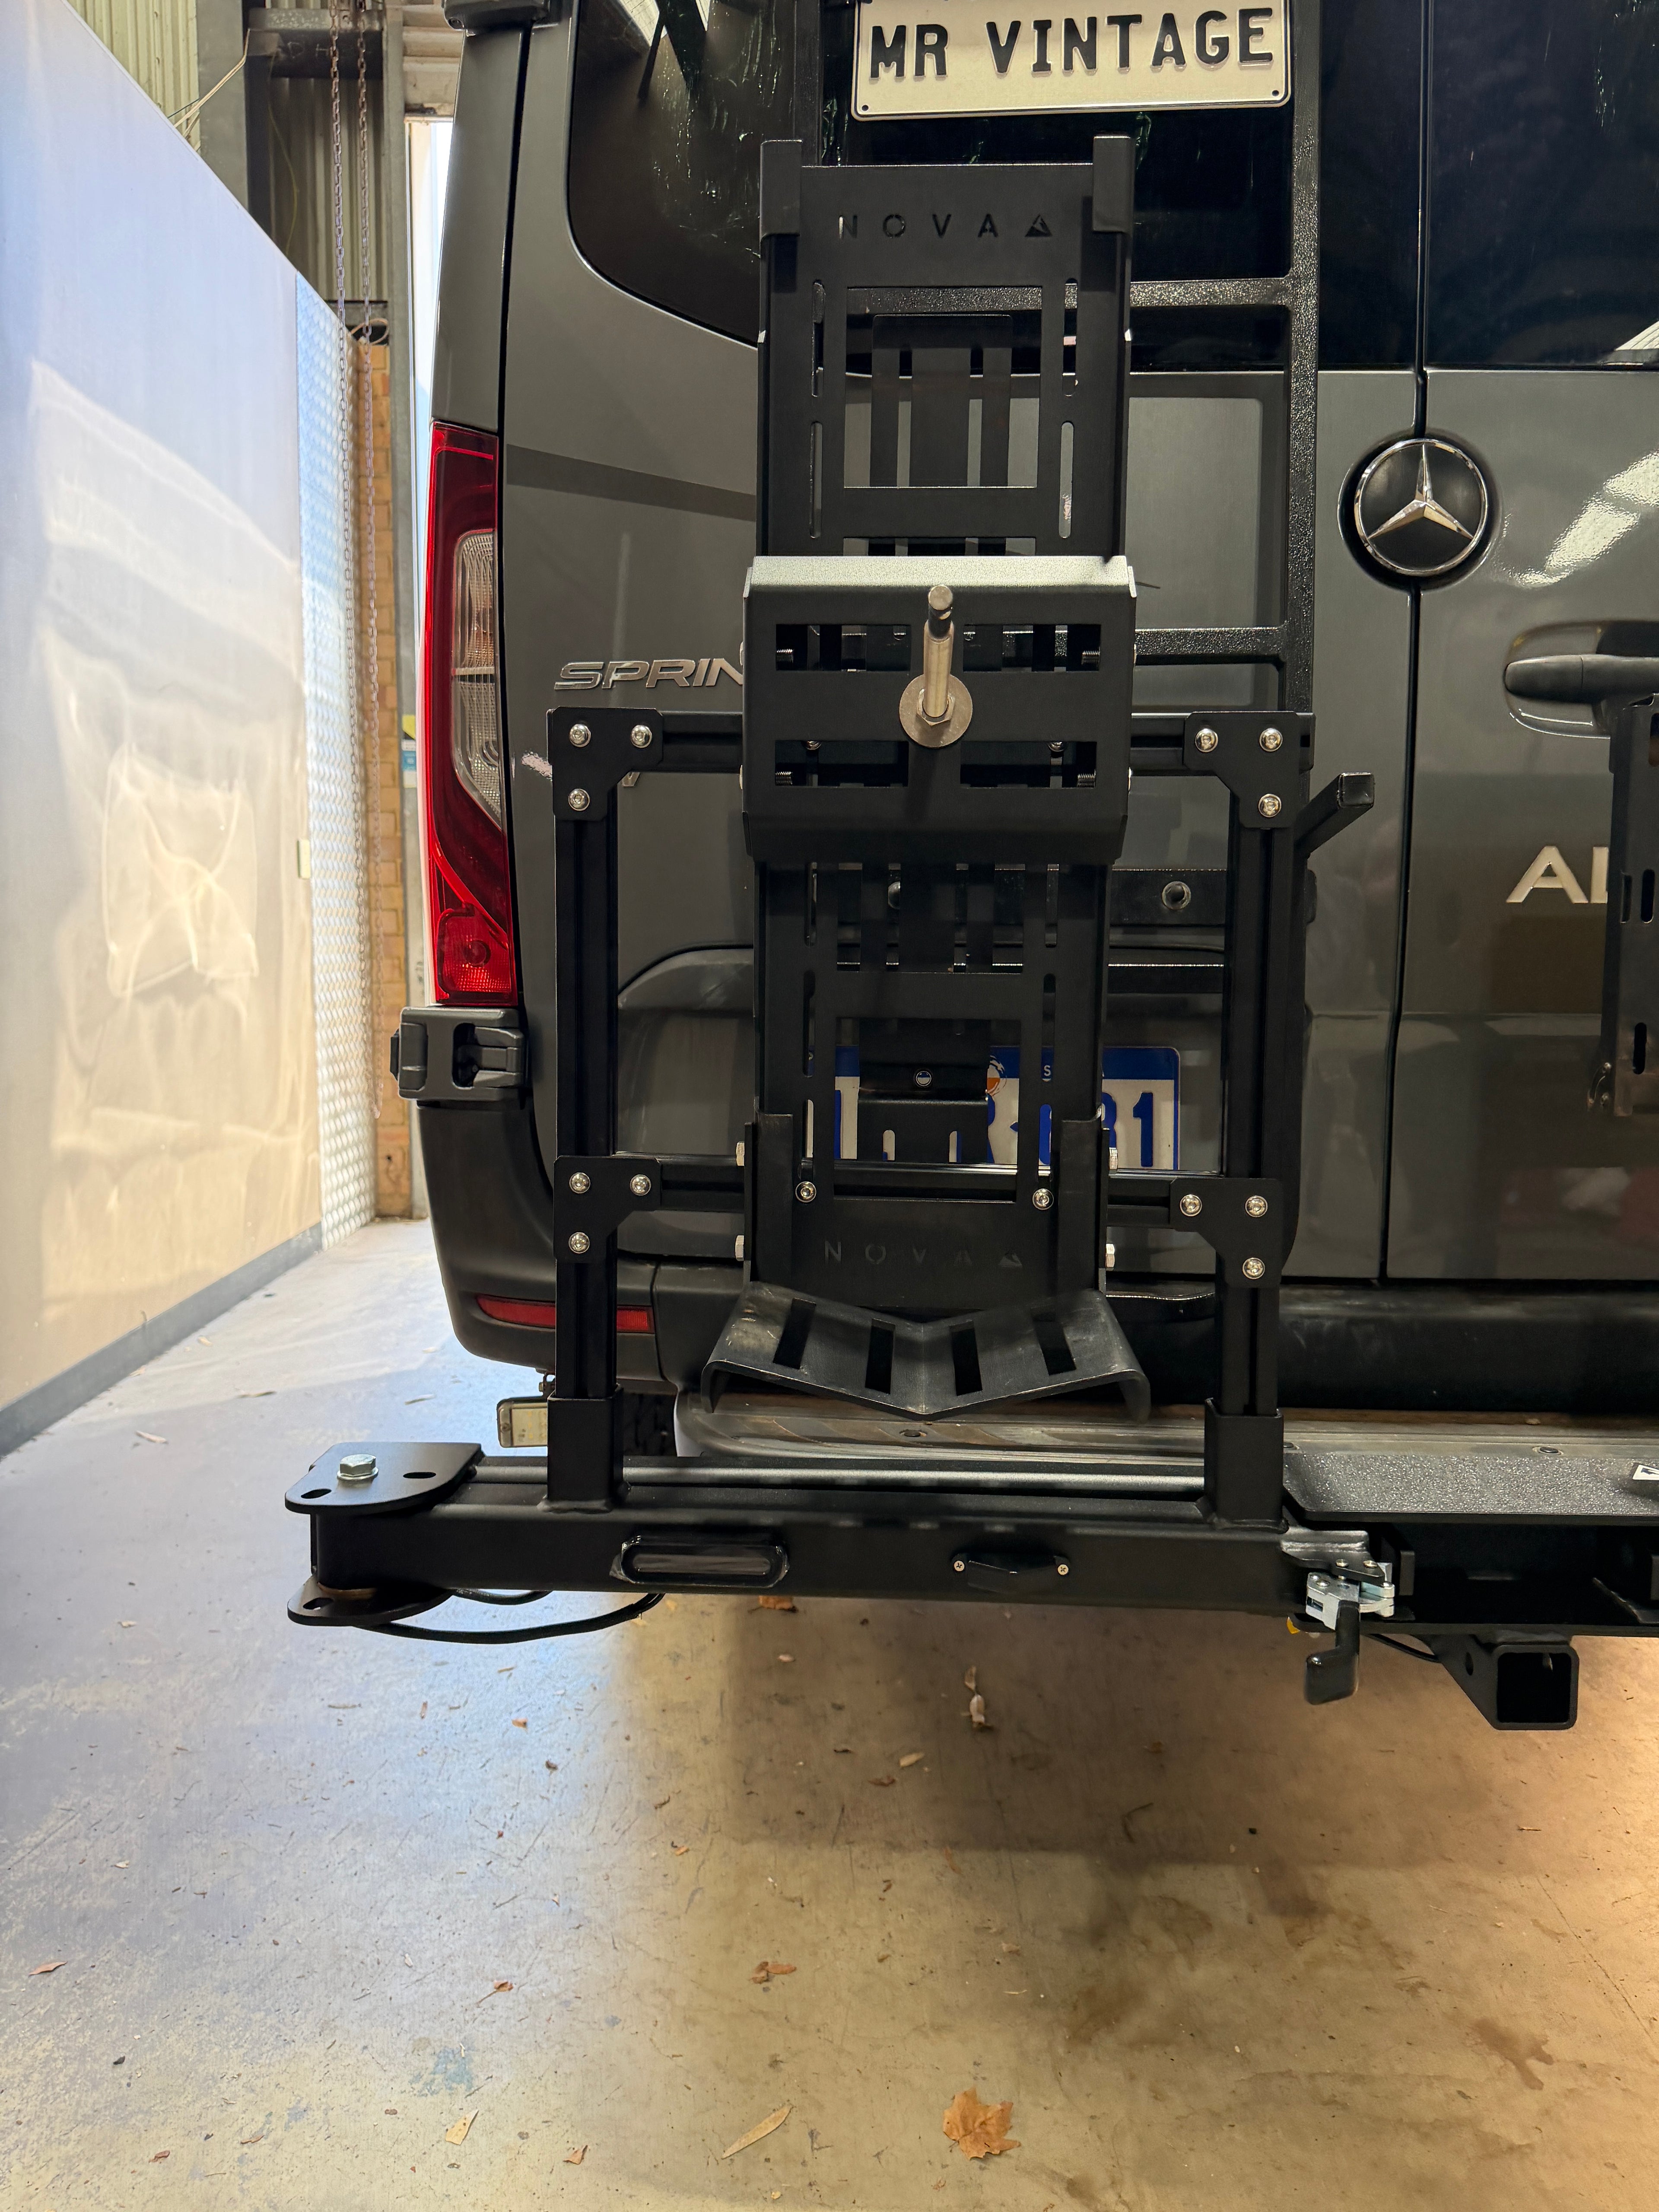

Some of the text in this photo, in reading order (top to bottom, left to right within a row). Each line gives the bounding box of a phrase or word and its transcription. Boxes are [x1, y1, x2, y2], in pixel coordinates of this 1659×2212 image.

[869, 7, 1273, 79] MR VINTAGE
[838, 213, 999, 238] NOVA
[824, 1241, 973, 1266] NOVA
